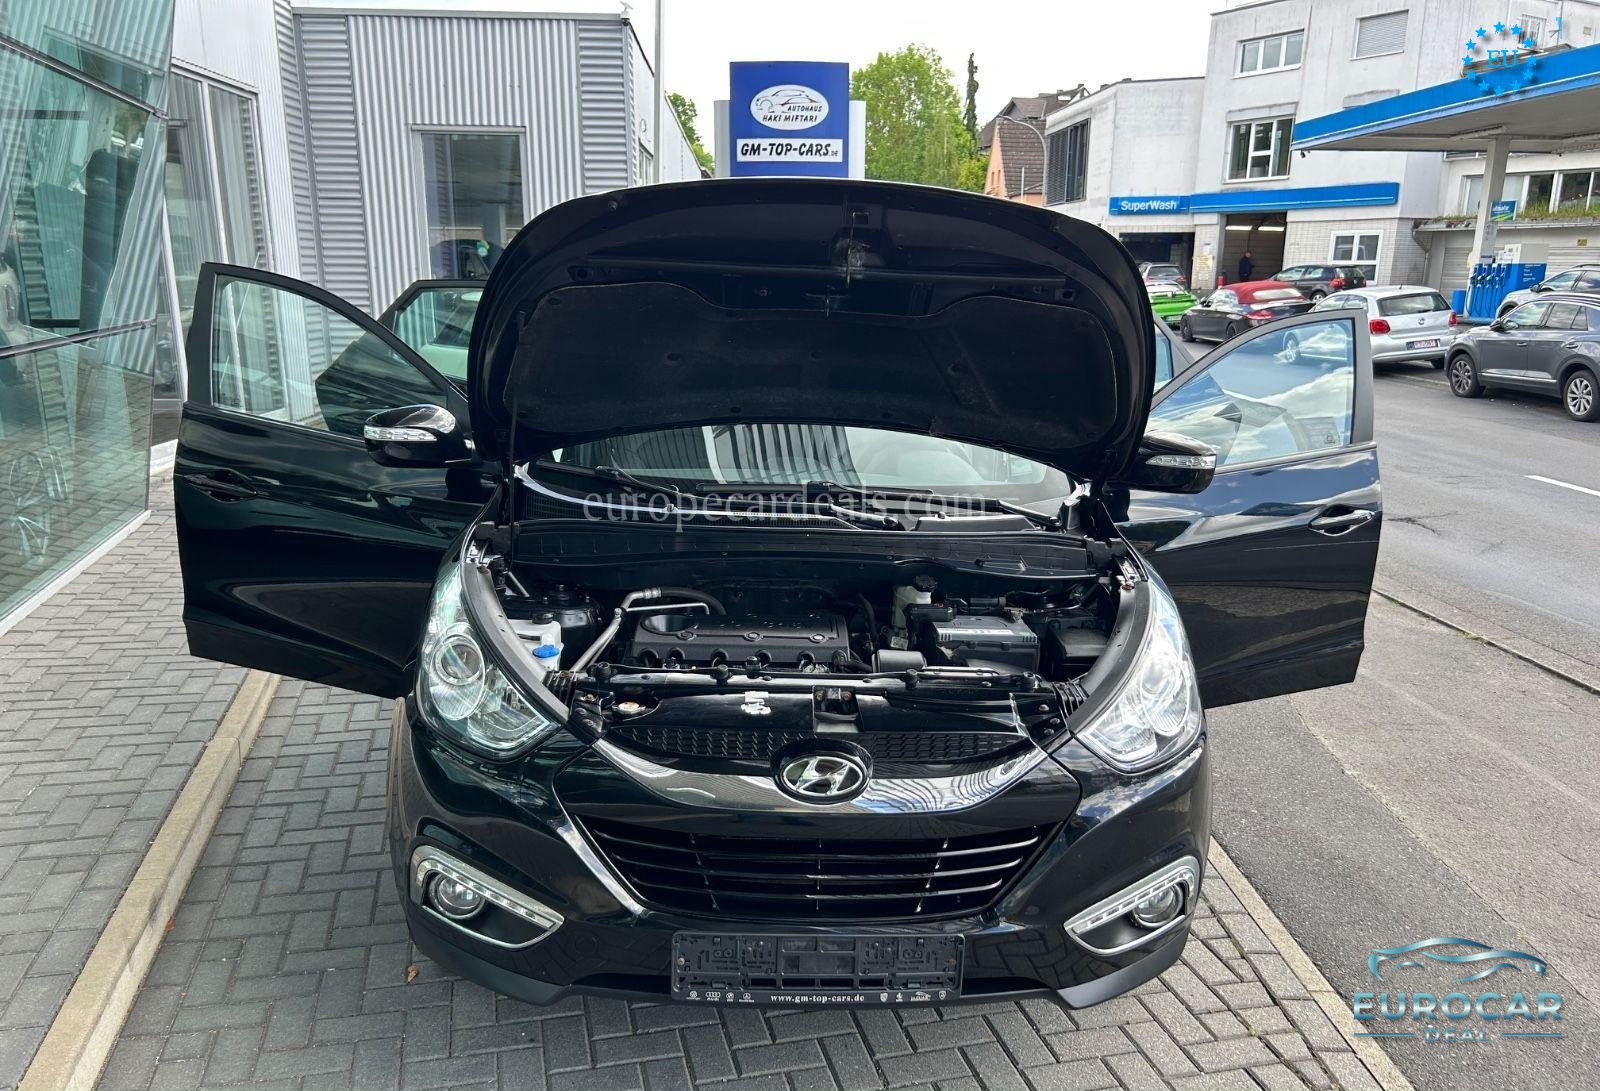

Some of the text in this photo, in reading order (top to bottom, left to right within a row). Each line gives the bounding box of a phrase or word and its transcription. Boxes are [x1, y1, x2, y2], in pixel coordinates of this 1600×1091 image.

[762, 114, 818, 122] HAKI MIFTARI
[1120, 199, 1177, 213] SuperWash
[770, 993, 865, 1004] www.gm-top-cars.de
